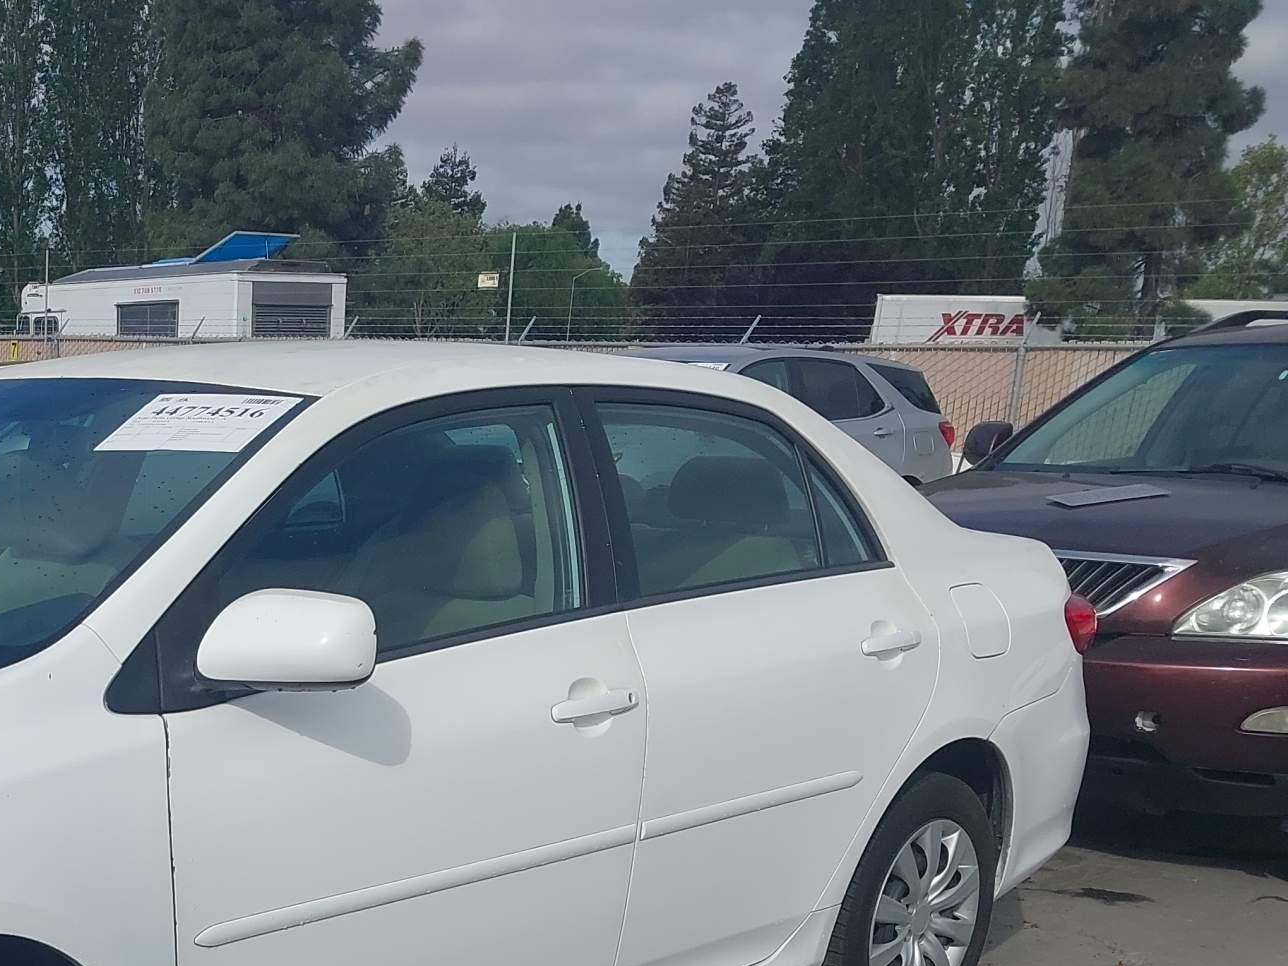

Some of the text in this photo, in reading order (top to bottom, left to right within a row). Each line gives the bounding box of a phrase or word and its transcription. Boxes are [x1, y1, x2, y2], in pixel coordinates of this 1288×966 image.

[923, 310, 1025, 343] XTRA
[11, 342, 18, 358] 7
[152, 405, 270, 419] 44774516
